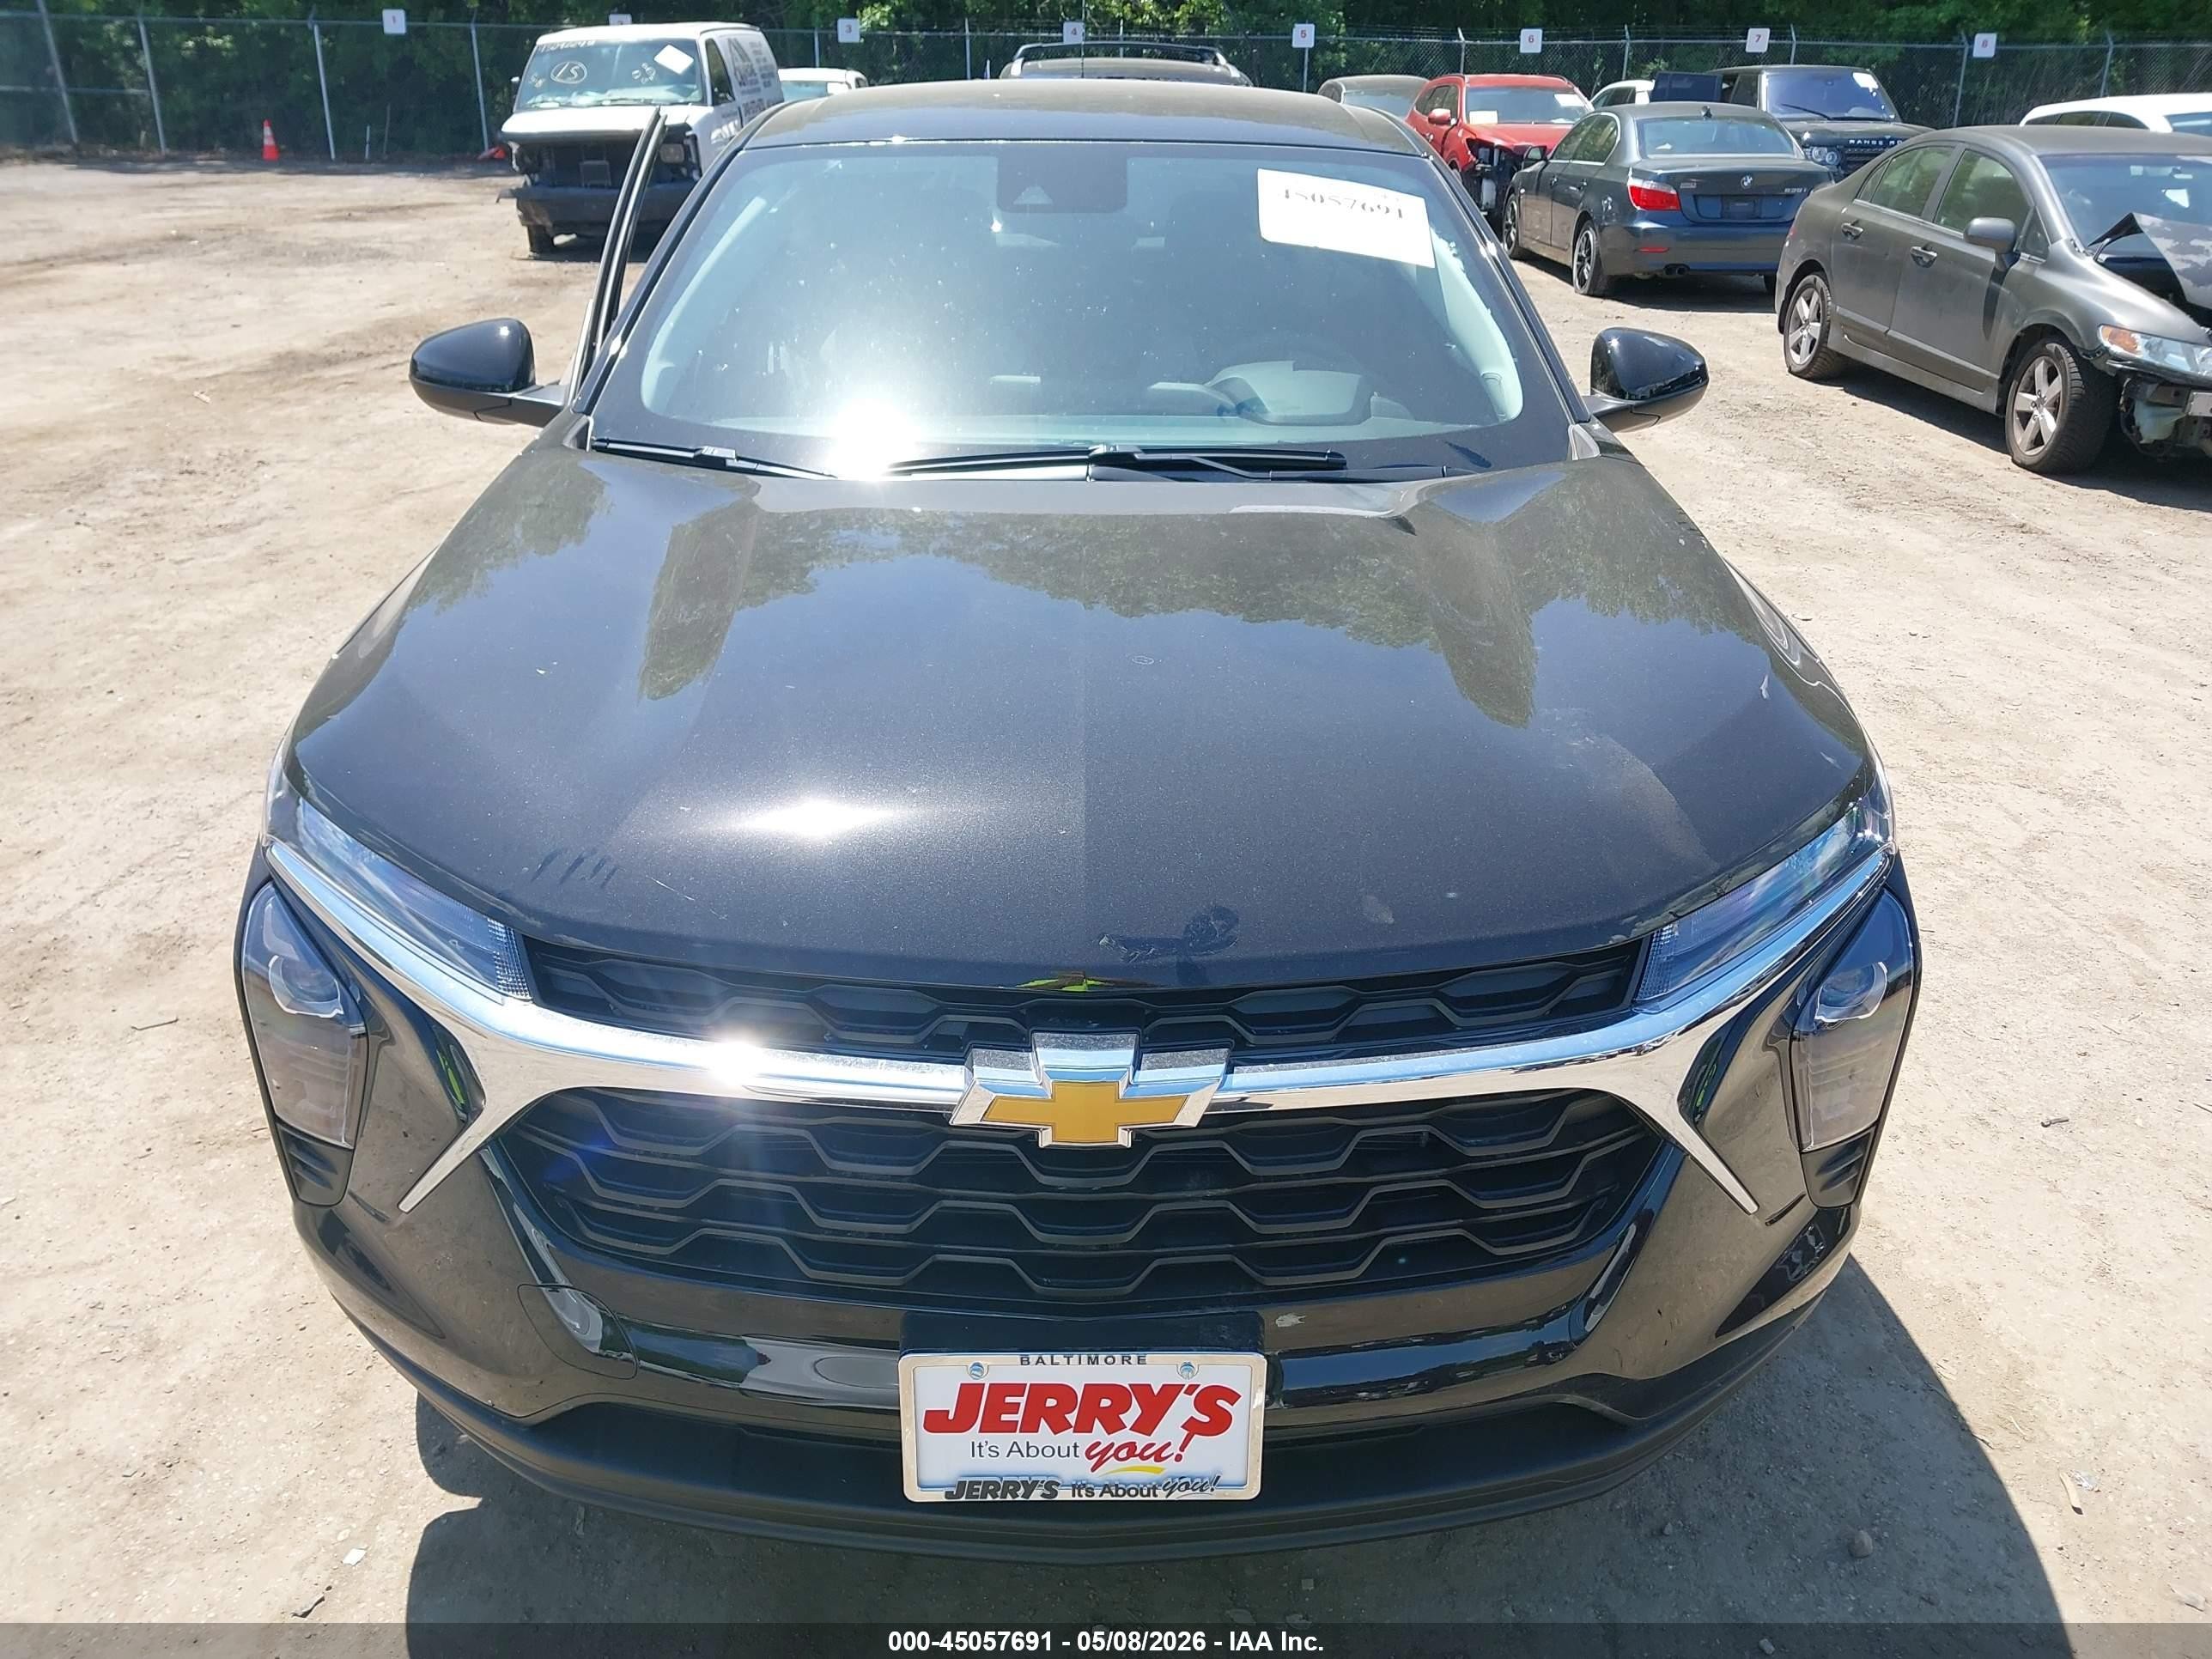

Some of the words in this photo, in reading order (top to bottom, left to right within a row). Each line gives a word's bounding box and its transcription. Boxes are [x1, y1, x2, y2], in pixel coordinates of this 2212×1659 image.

[846, 24, 852, 33] 3
[1071, 27, 1077, 35] 4
[1300, 30, 1307, 39] 5
[1528, 34, 1534, 43] 6
[1754, 34, 1761, 43] 7
[1020, 1355, 1147, 1365] BALTIMORE
[923, 1382, 1242, 1437] JERRY'S
[971, 1441, 1000, 1457] It's
[1006, 1441, 1079, 1458] About
[1085, 1433, 1195, 1473] you!
[945, 1479, 1060, 1500] JERRY'S
[1071, 1482, 1095, 1498] It's
[1098, 1483, 1159, 1498] About
[1162, 1475, 1221, 1499] you!
